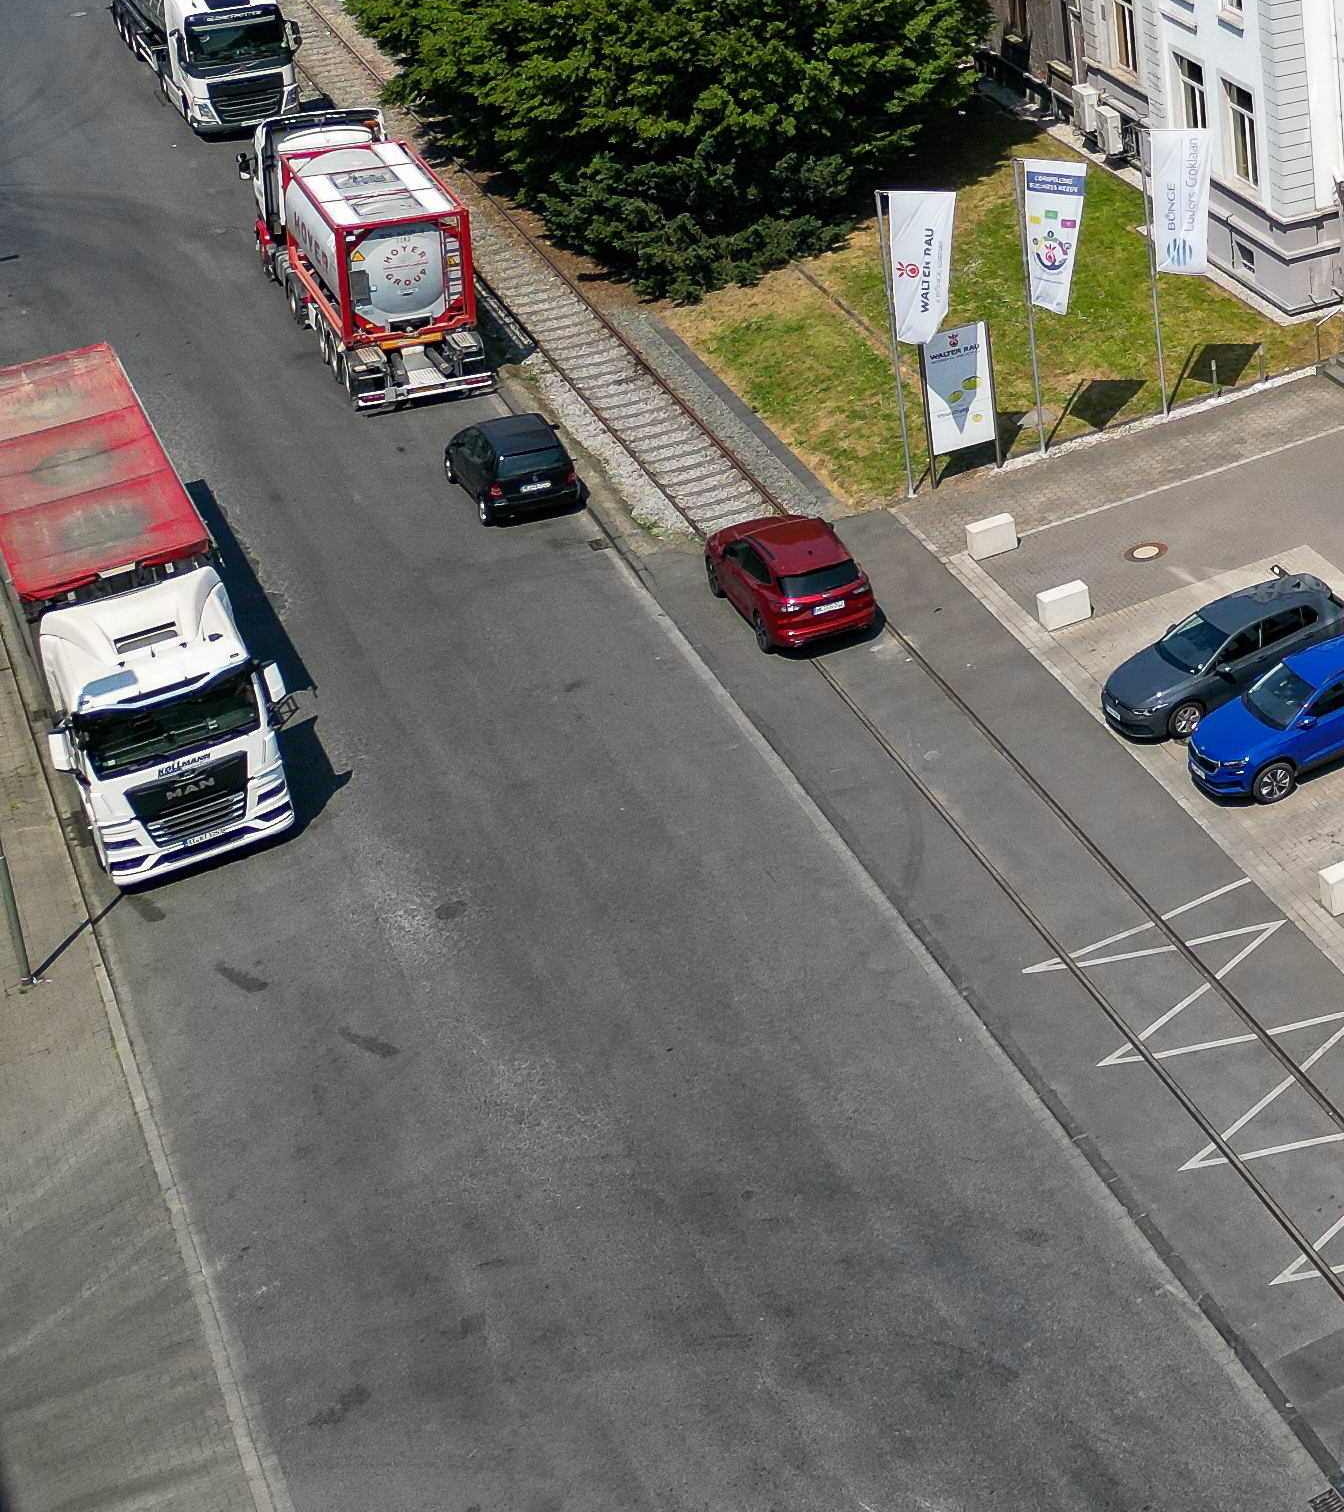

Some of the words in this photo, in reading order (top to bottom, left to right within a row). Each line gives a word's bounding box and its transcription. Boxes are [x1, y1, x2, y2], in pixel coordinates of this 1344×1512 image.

[383, 245, 427, 263] HOYER
[385, 268, 427, 286] GROUP
[165, 777, 215, 800] MAN
